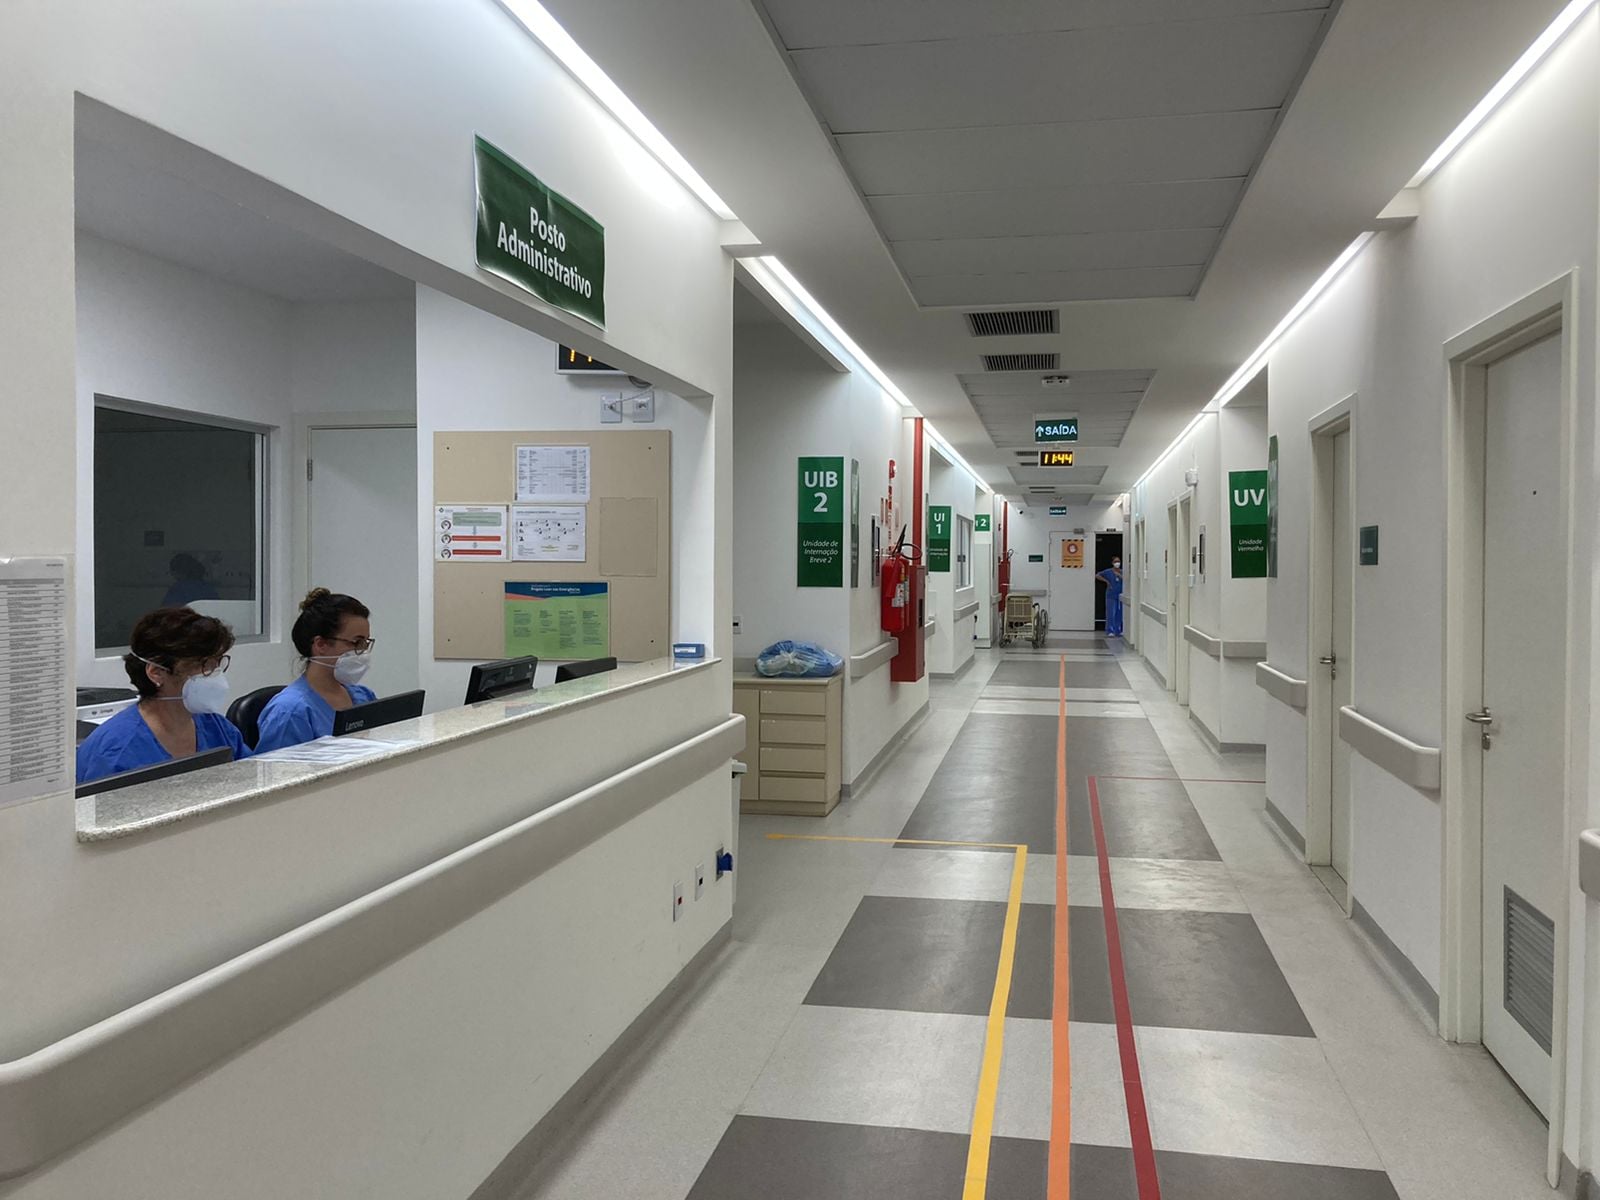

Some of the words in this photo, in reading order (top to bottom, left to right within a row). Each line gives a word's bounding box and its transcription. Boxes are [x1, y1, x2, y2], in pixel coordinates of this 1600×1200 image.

[530, 206, 566, 252] Posto
[497, 221, 592, 299] Administrativo
[1045, 423, 1077, 436] SAÍDA
[1044, 453, 1073, 464] 11:44
[804, 470, 838, 488] UIB
[813, 491, 828, 513] 2
[1233, 488, 1265, 507] UV
[934, 512, 945, 522] UI
[980, 518, 987, 527] 2
[936, 523, 942, 535] 1
[802, 539, 829, 547] Unidade
[830, 539, 839, 547] de
[804, 548, 839, 557] Internação
[827, 556, 833, 564] 2
[345, 719, 364, 732] Lenovo
